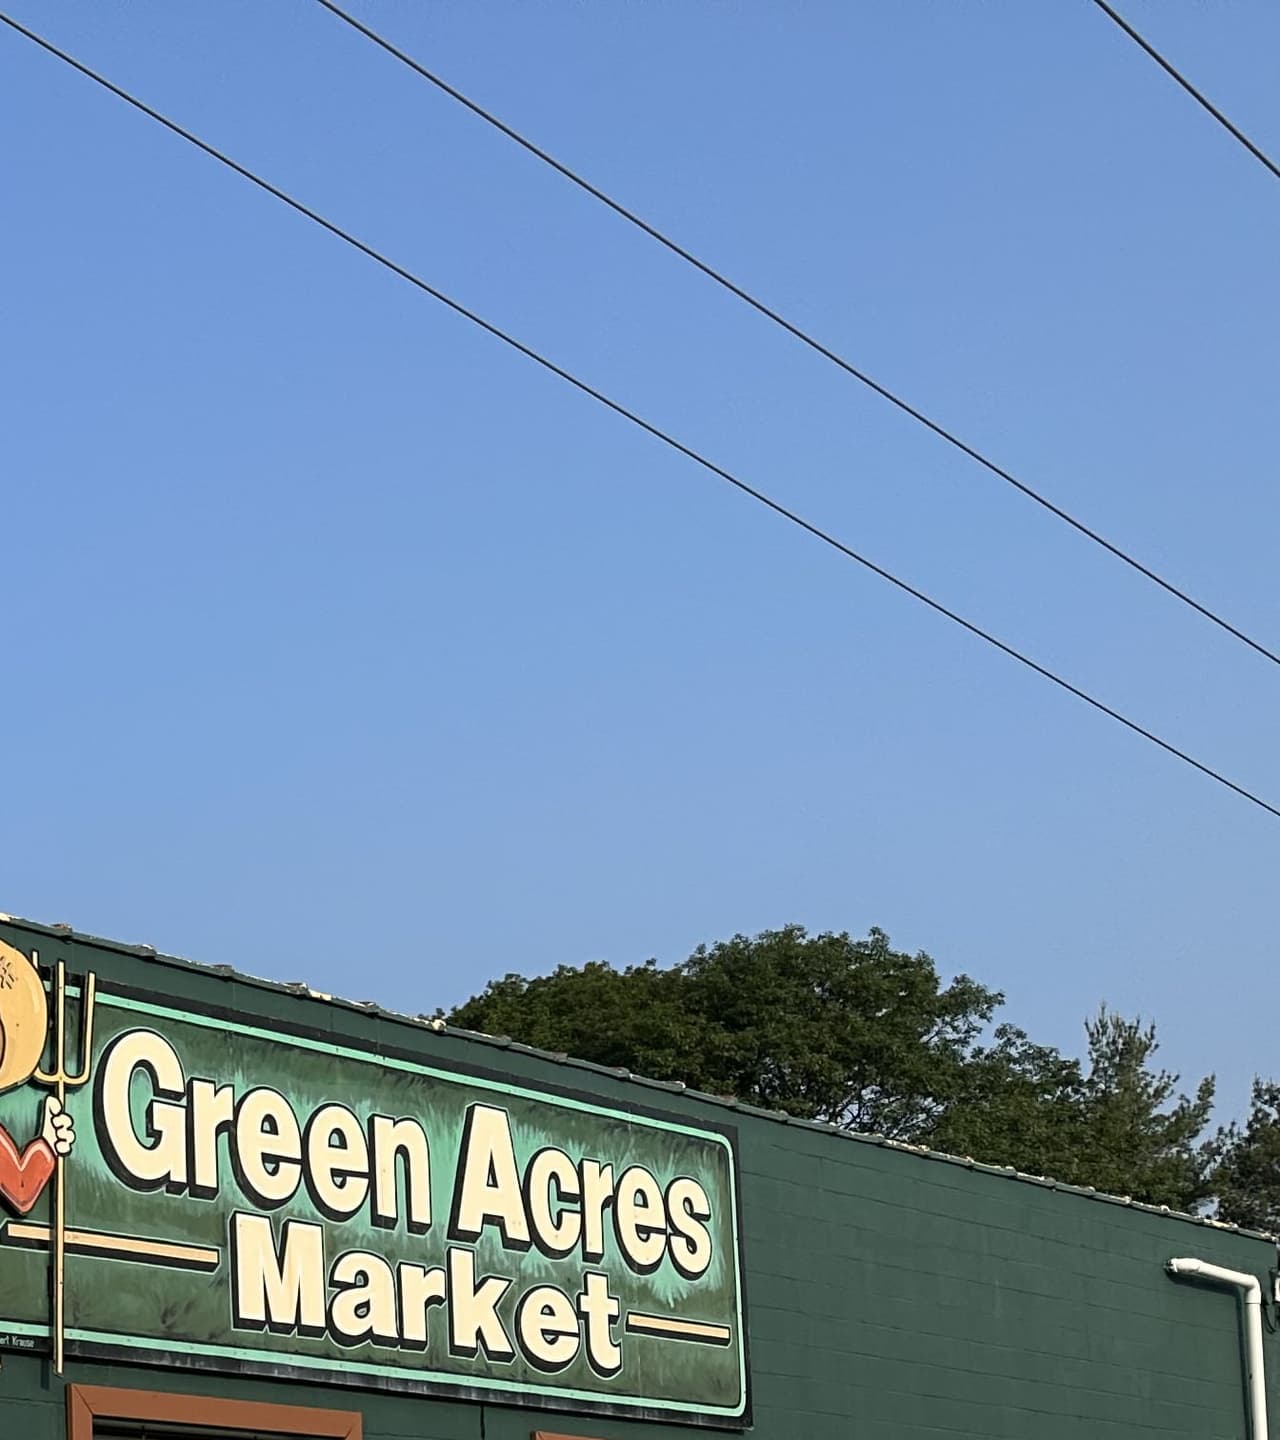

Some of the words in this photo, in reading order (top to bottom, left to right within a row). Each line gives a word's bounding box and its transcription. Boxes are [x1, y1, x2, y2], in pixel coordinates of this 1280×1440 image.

[97, 1029, 430, 1232] Green
[449, 1103, 711, 1277] Acres
[232, 1212, 622, 1376] Market
